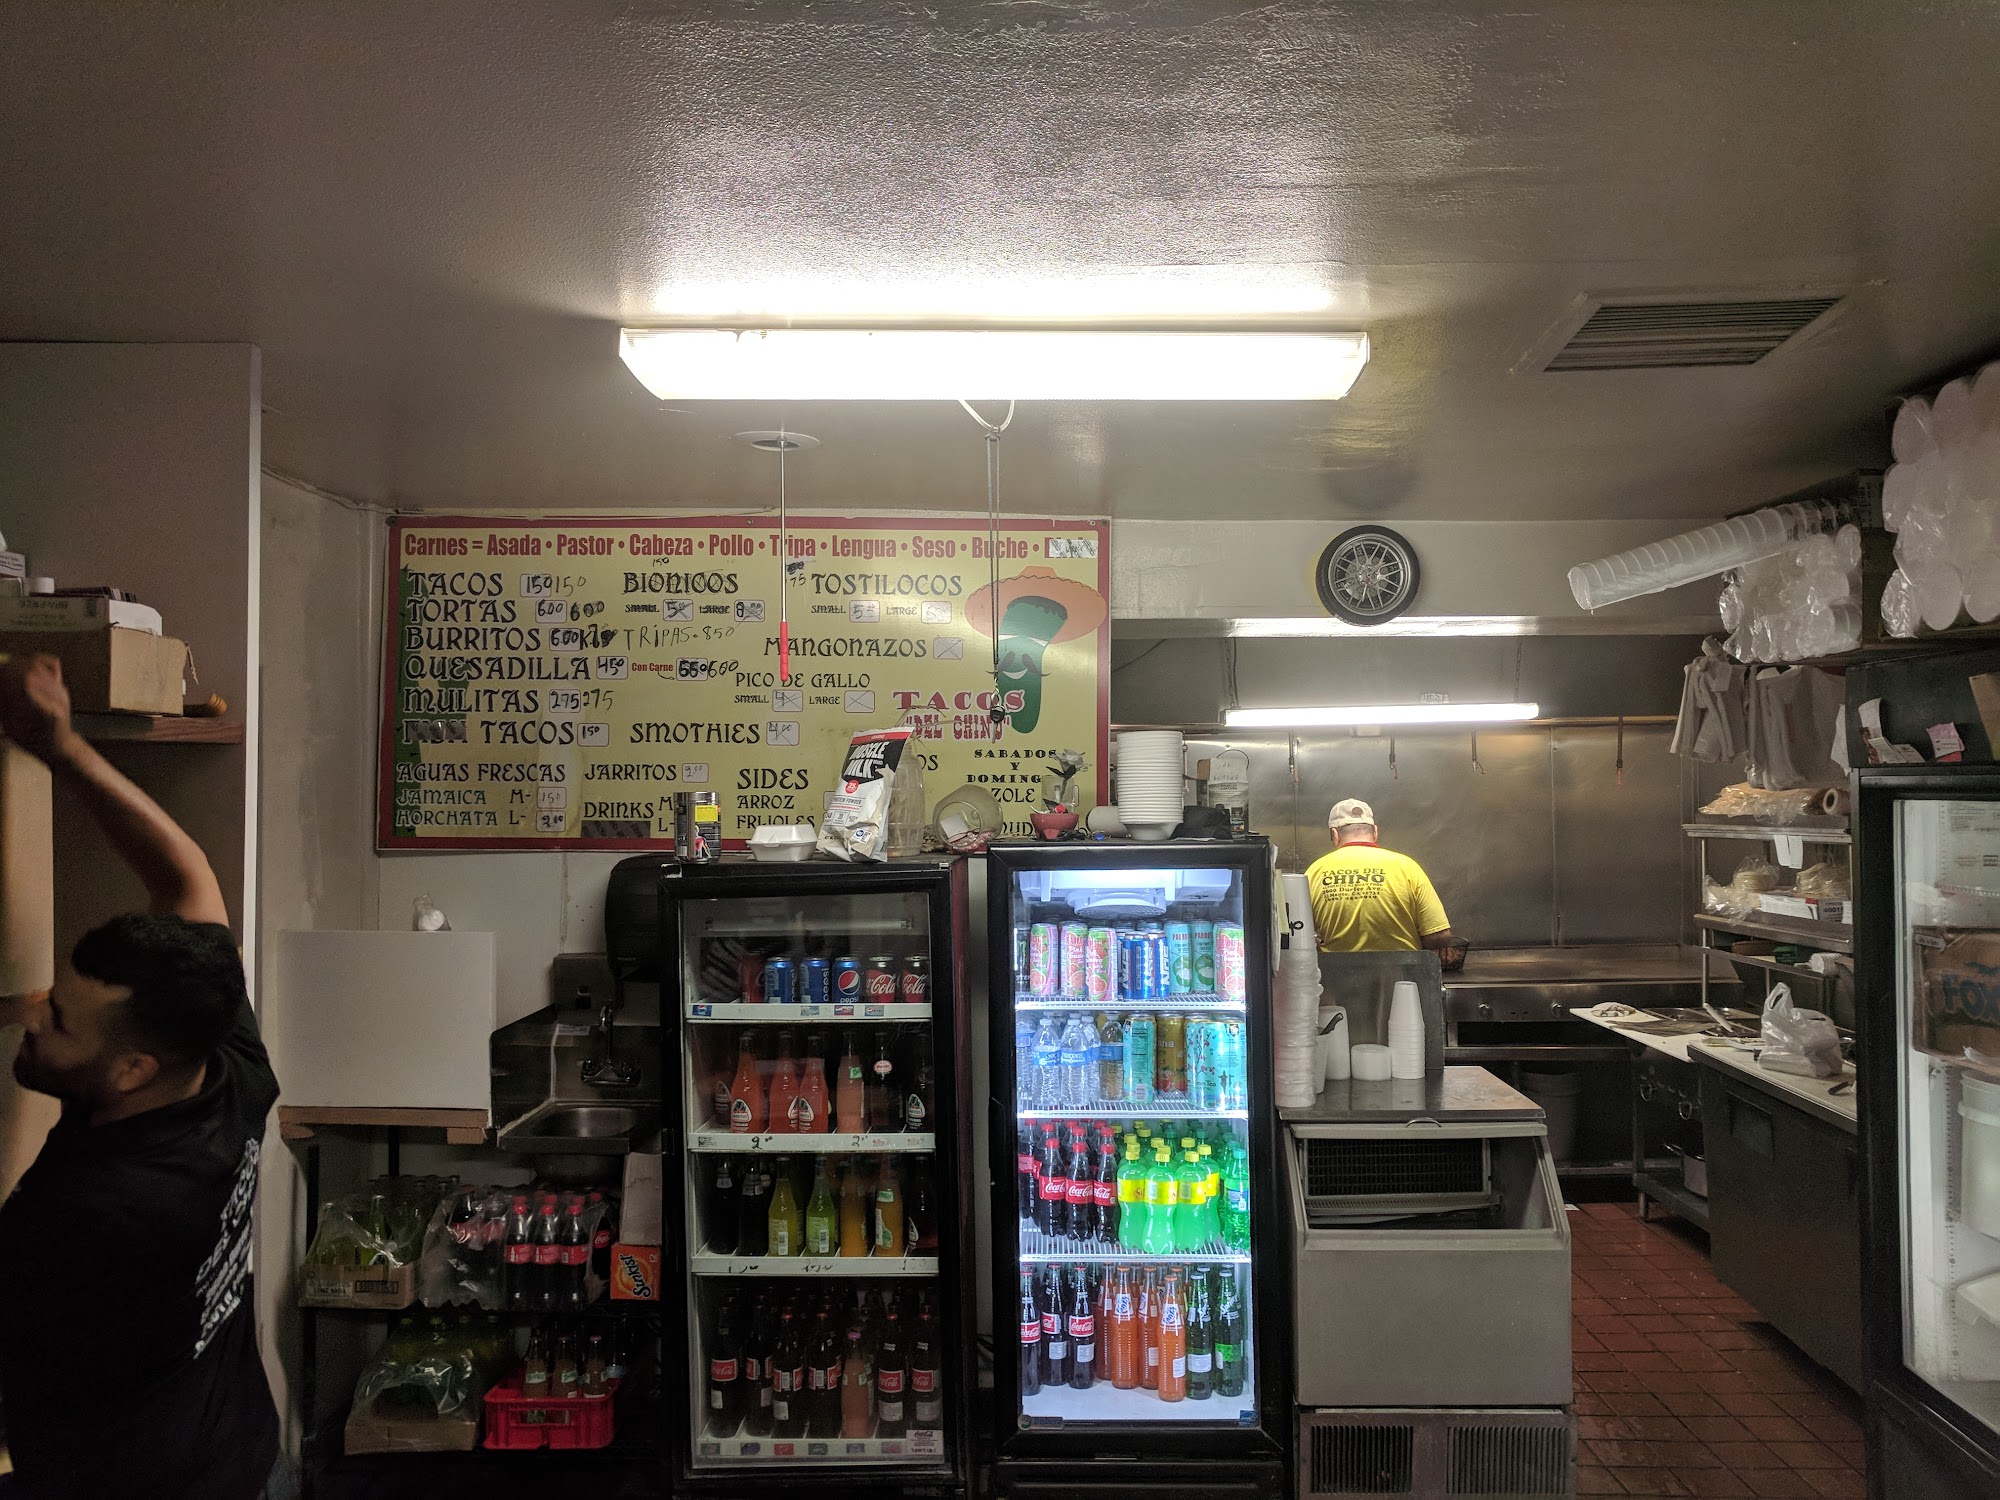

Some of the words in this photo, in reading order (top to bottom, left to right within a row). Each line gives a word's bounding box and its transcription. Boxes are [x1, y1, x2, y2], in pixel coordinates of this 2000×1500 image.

[404, 533, 468, 557] Carnes
[487, 534, 541, 556] Asada
[557, 534, 614, 556] Pastor
[629, 534, 693, 557] Cabeza
[709, 534, 754, 557] Pollo
[832, 535, 897, 560] Lengua
[912, 536, 956, 559] Seso
[972, 536, 1028, 559] Buche
[407, 572, 504, 597] TACOS
[623, 572, 739, 594] BIONICOS
[811, 573, 963, 596] TOSTILOCOS
[406, 599, 517, 623] TORTAS
[811, 605, 846, 614] SMALL
[886, 606, 917, 616] LARGE
[406, 627, 541, 651] BURRITOS
[764, 637, 927, 657] MANGONAZOS
[405, 655, 591, 680] QUESADILLA
[632, 663, 648, 671] Con
[649, 663, 674, 672] Carne
[736, 673, 775, 687] PICO
[782, 674, 804, 687] DE
[811, 674, 870, 688] GALLO
[404, 688, 539, 713] MULITAS
[734, 695, 769, 703] SMALL
[809, 697, 841, 705] LARGE
[893, 691, 1025, 710] TACOS
[480, 720, 575, 744] TACOS
[630, 722, 760, 745] SMOTHIES
[974, 749, 1057, 759] SABADOS
[397, 763, 469, 782] AGUAS
[477, 763, 566, 782] FRESCAS
[584, 763, 677, 781] JARRITOS
[1010, 762, 1021, 771] Y
[737, 769, 809, 790] SIDES
[966, 774, 1041, 783] DOMING
[396, 789, 487, 805] JAMAICA
[737, 795, 795, 810] ARROZ
[396, 810, 498, 826] HORCHATA
[583, 801, 655, 819] DRINKS
[1322, 868, 1359, 877] TACOS
[1322, 874, 1385, 886] CHINO
[618, 1253, 652, 1297] Sunkist
